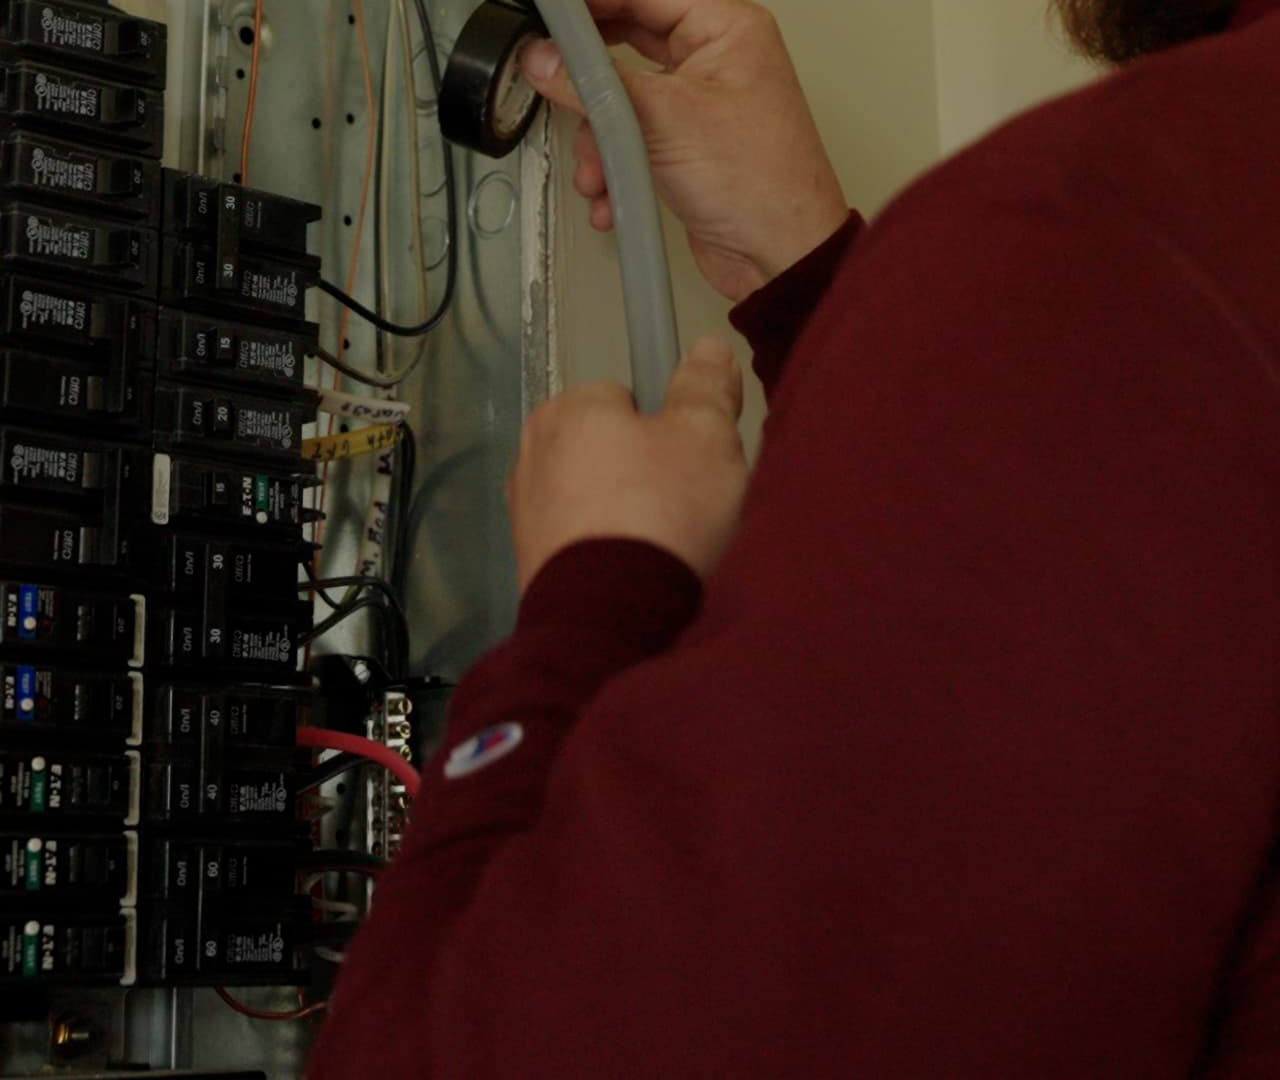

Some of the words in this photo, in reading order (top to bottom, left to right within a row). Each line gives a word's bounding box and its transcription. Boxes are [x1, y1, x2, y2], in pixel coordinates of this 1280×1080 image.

[225, 195, 236, 211] 30
[224, 263, 234, 279] 30
[220, 337, 231, 349] 15
[217, 407, 229, 422] 20
[212, 554, 224, 570] 30
[209, 628, 221, 644] 30
[209, 710, 220, 727] 40
[206, 783, 218, 800] 40
[207, 861, 219, 878] 60
[204, 940, 217, 957] 60
